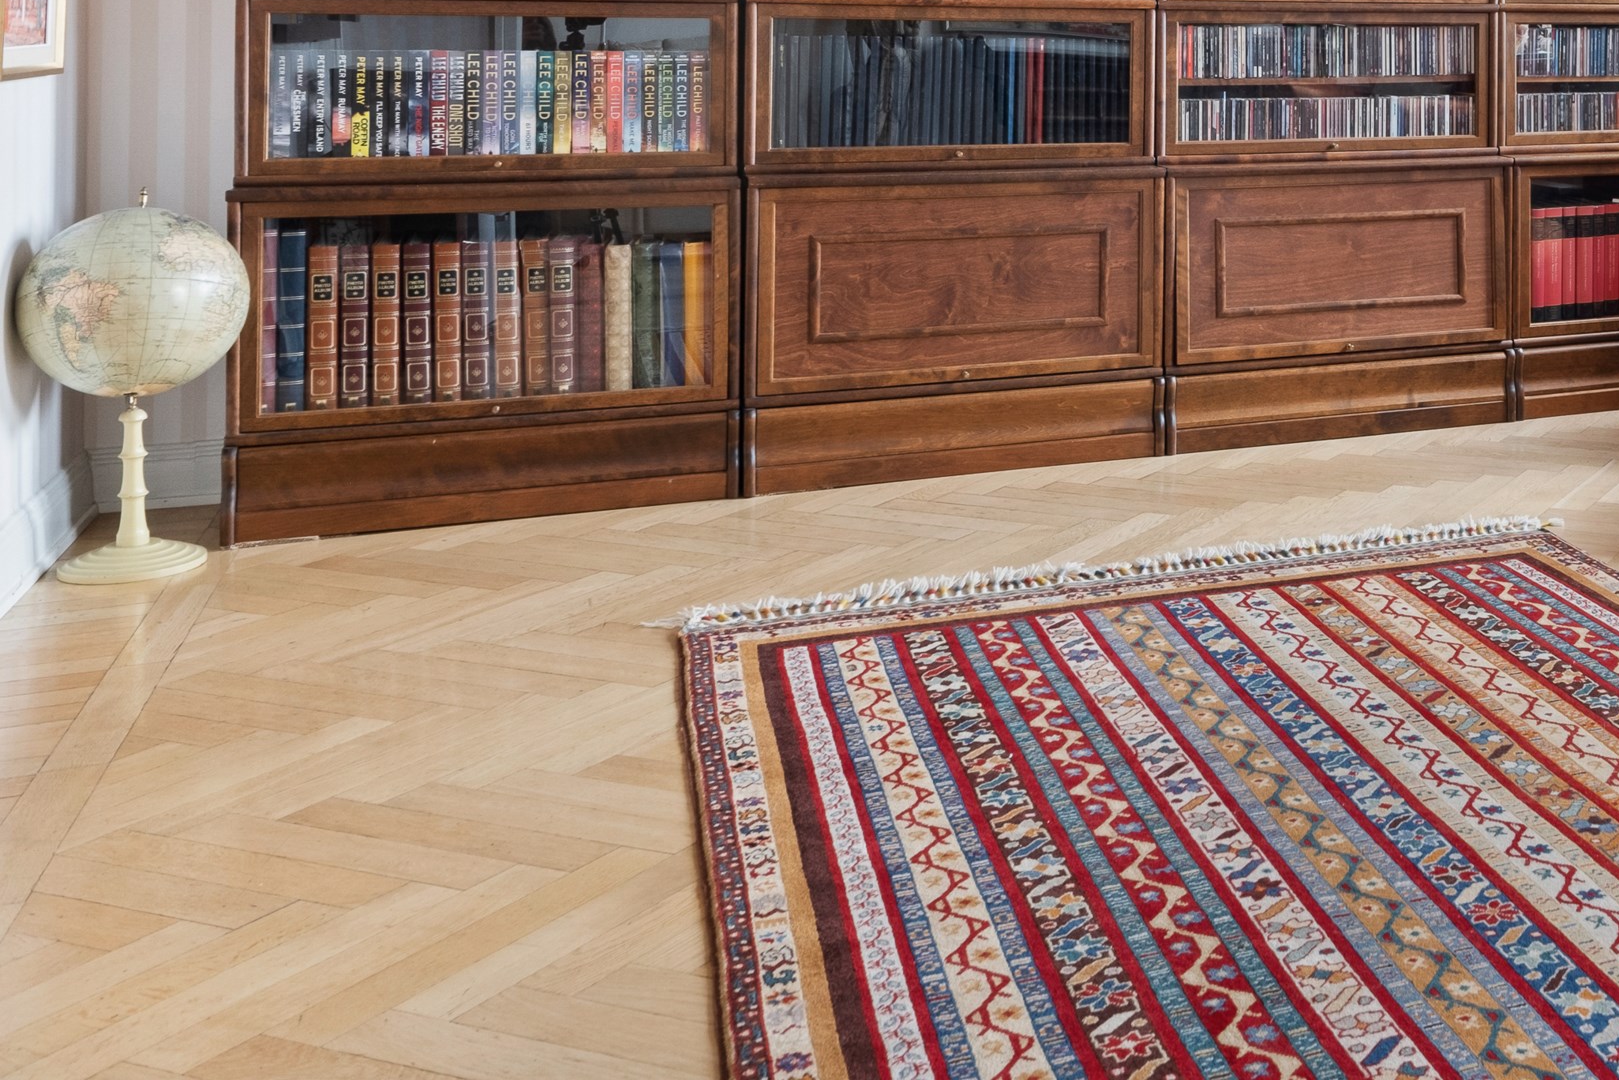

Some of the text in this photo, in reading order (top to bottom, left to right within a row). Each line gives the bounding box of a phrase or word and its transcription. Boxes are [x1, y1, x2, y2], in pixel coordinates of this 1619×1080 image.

[317, 55, 325, 78] PETER
[356, 57, 365, 104] PETER MAY
[468, 54, 479, 119] LEE CHILD
[539, 56, 550, 119] LEE CHILD
[316, 99, 324, 122] ENTRY
[677, 64, 686, 117] LEE CHILD
[449, 104, 462, 147] ONE SHOT
